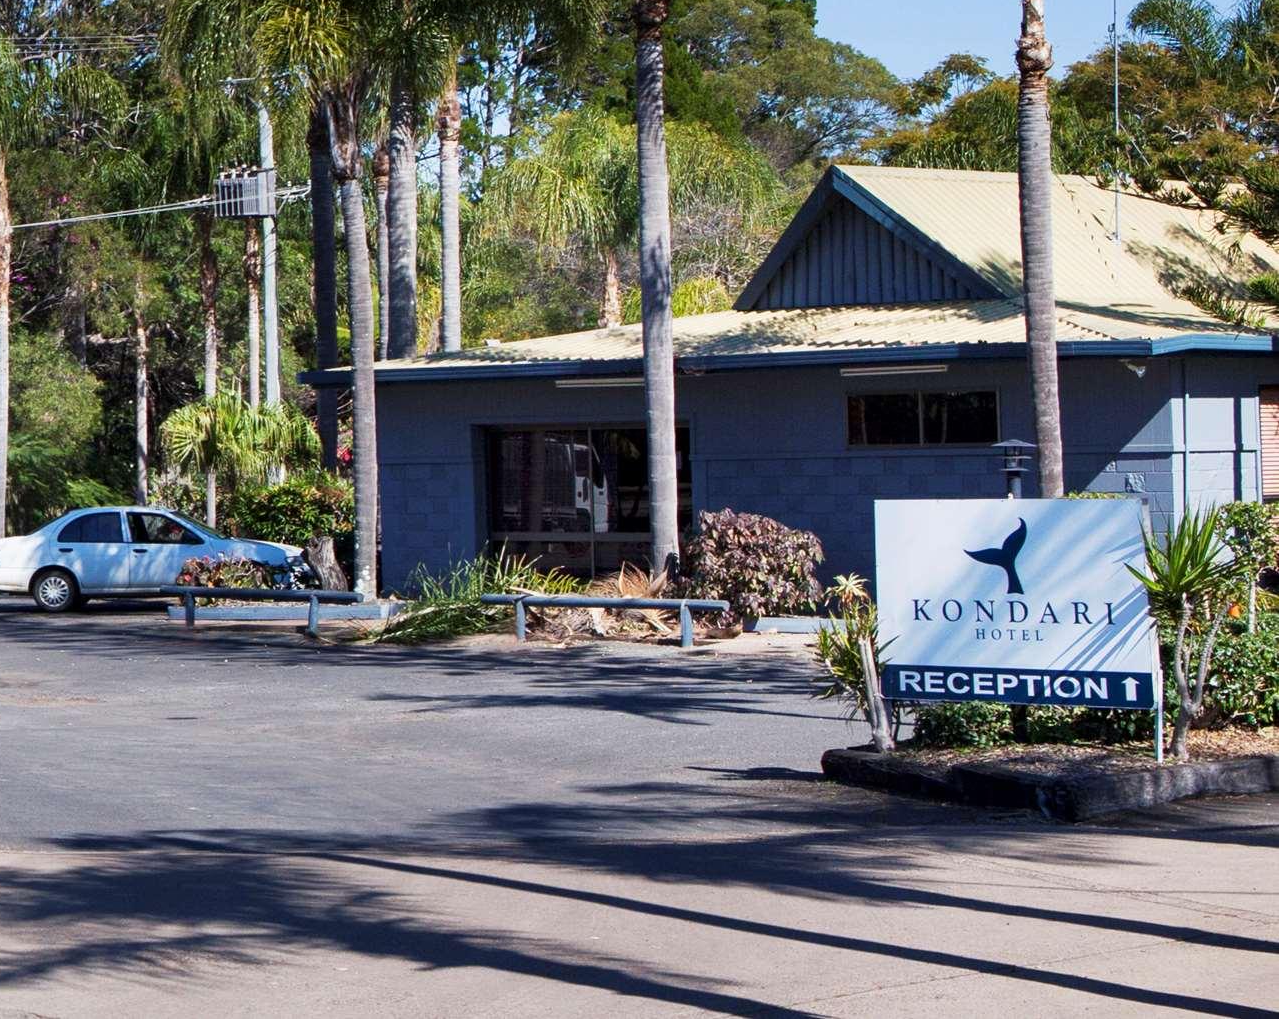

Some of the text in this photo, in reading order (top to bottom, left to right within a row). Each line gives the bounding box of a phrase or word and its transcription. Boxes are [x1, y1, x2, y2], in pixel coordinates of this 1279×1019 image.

[912, 599, 1116, 625] KONDARI
[975, 628, 1044, 642] HOTEL
[899, 671, 1109, 700] RECEPTION
